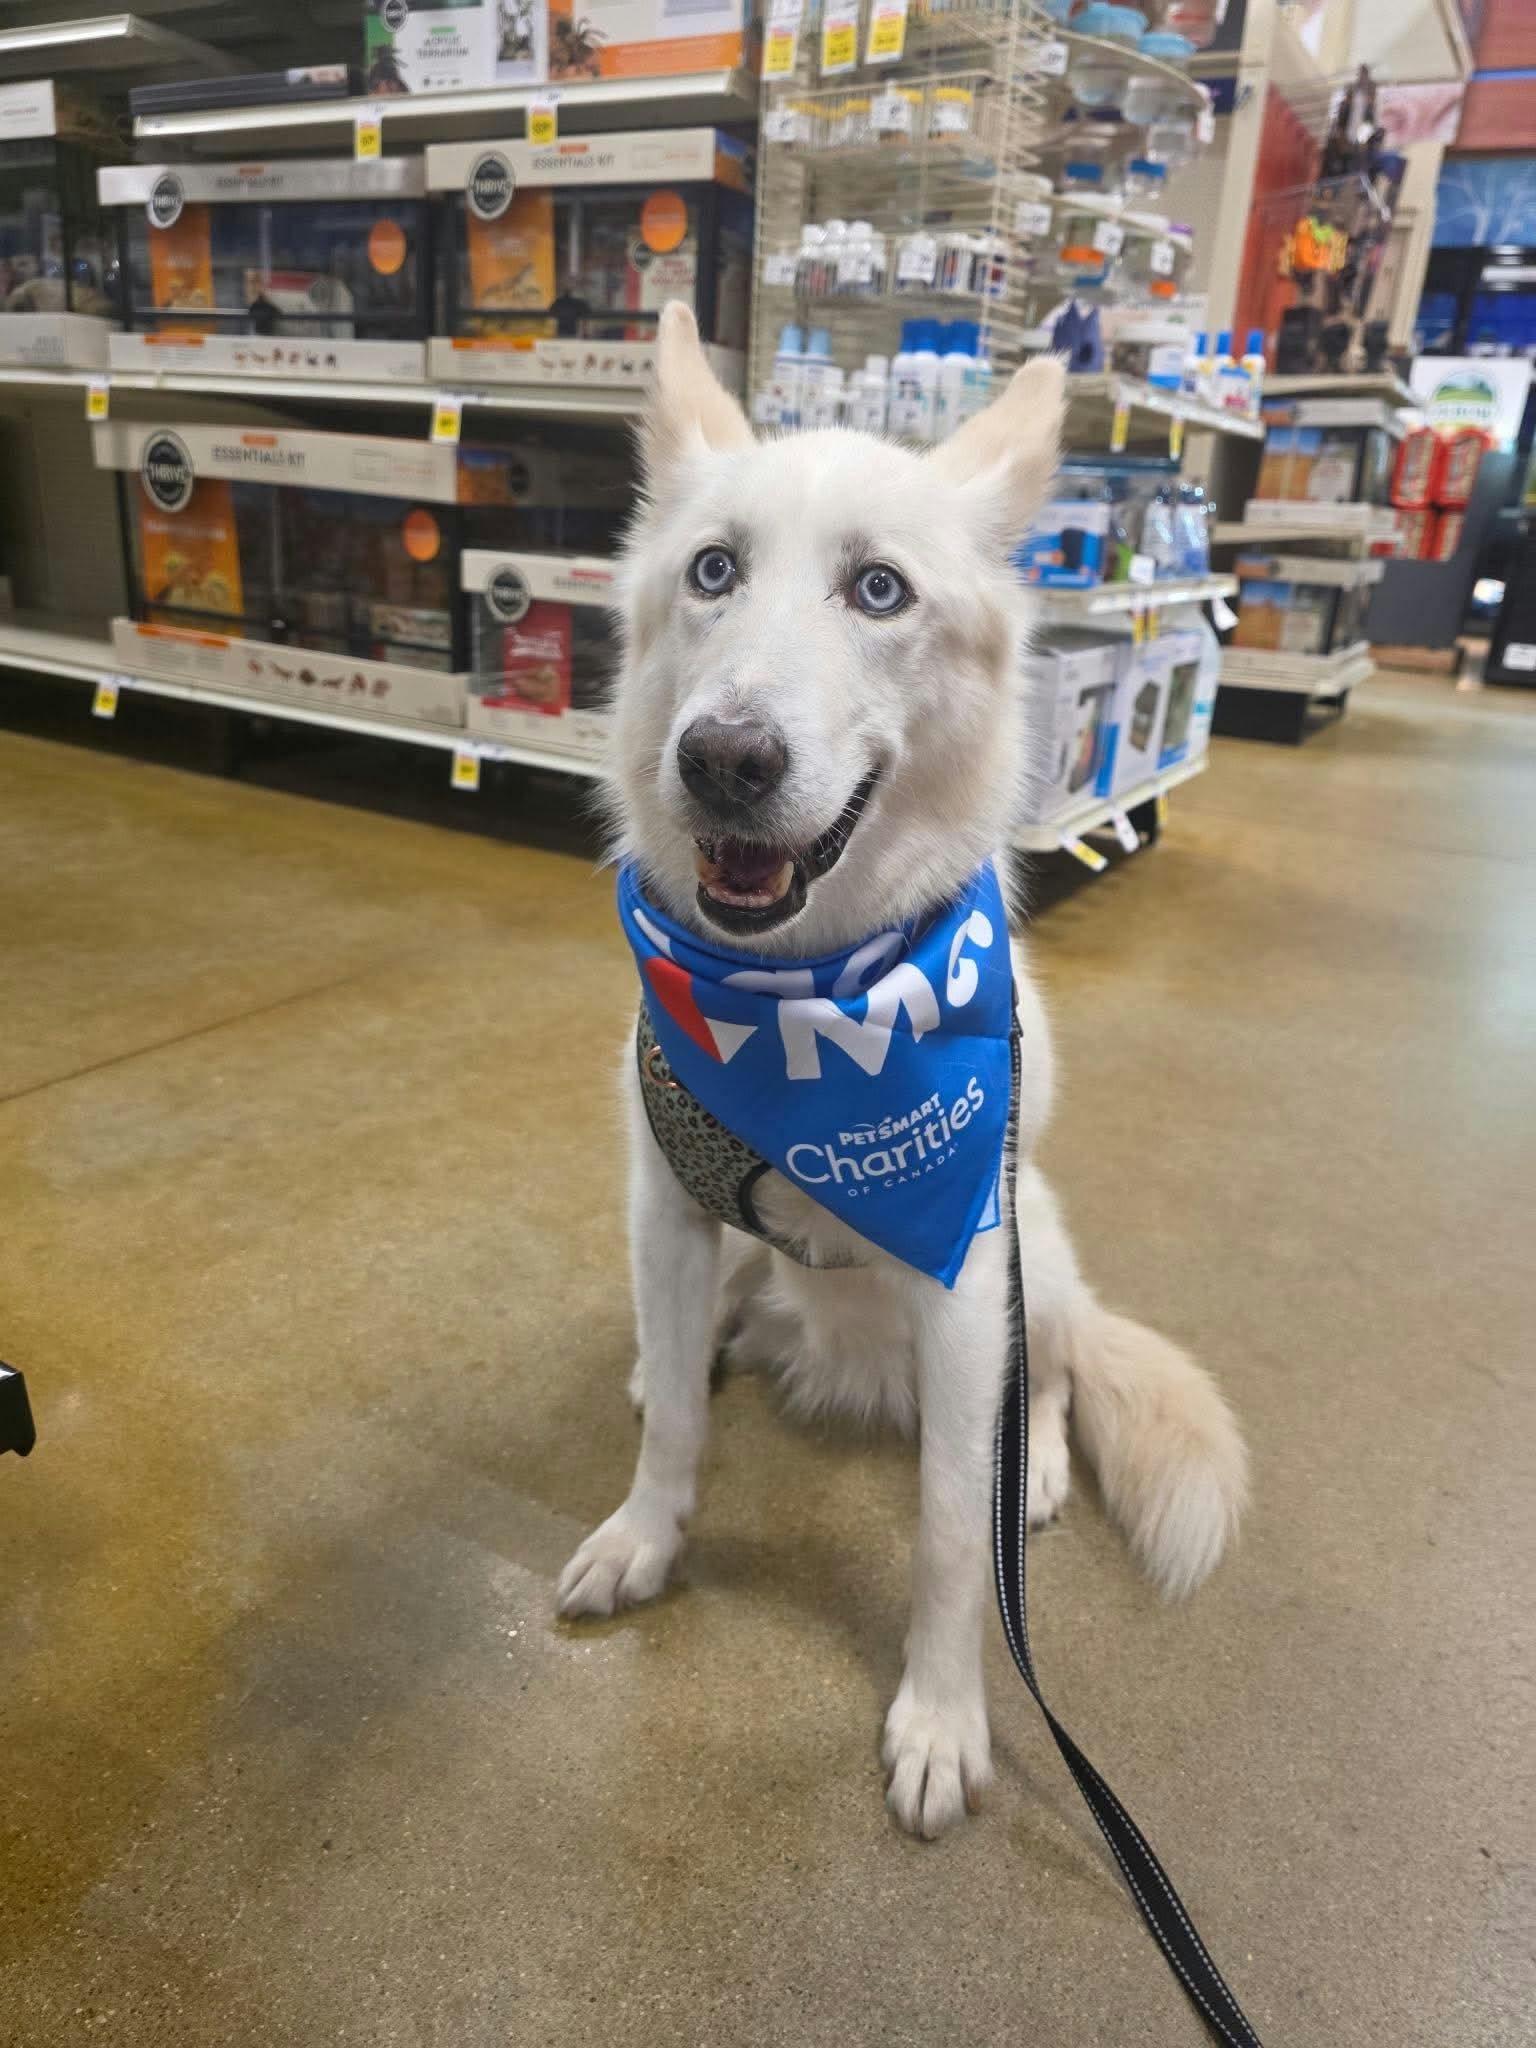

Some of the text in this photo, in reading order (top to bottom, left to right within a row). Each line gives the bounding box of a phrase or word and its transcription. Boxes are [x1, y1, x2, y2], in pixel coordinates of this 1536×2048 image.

[785, 1076, 985, 1184] Charities
[838, 1092, 941, 1145] PETSMART
[884, 1146, 957, 1188] CANADA
[848, 1185, 870, 1197] OF
